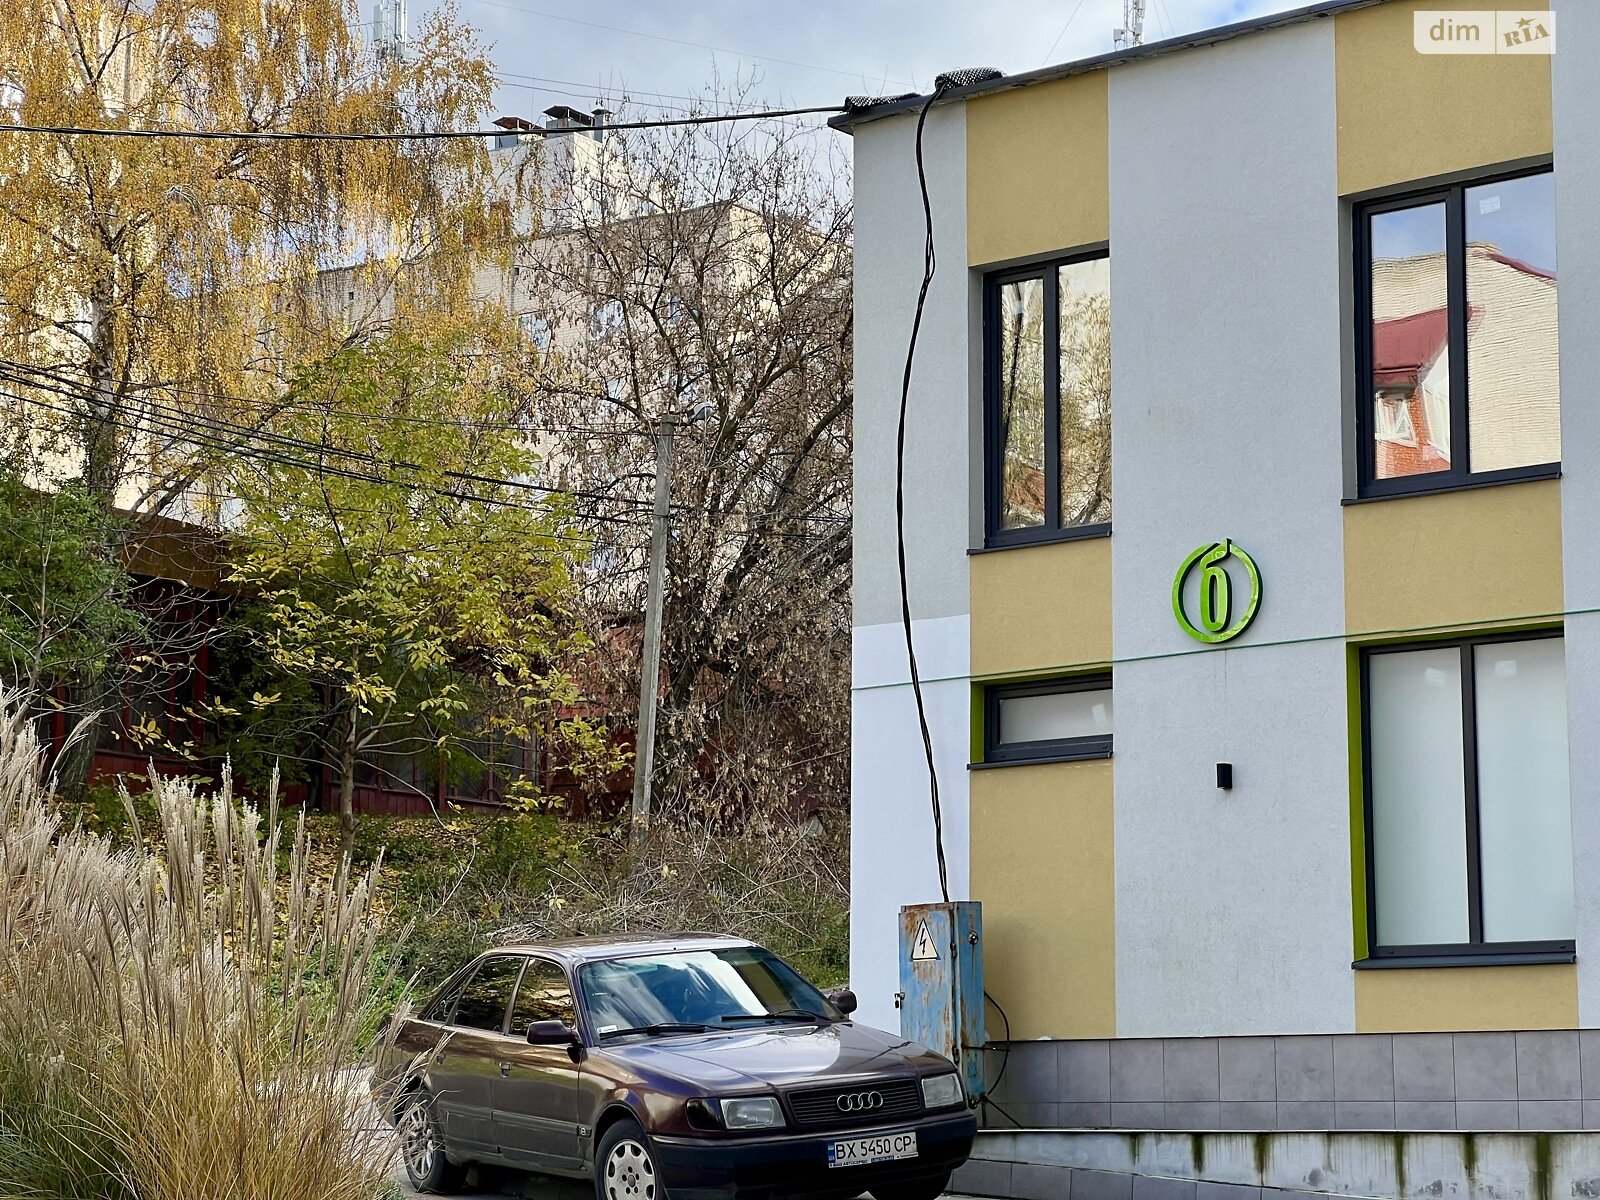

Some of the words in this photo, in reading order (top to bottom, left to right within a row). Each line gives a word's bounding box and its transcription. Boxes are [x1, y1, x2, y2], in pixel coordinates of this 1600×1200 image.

[836, 1142, 857, 1160] BX
[860, 1138, 891, 1157] 5450
[894, 1135, 912, 1152] CP
